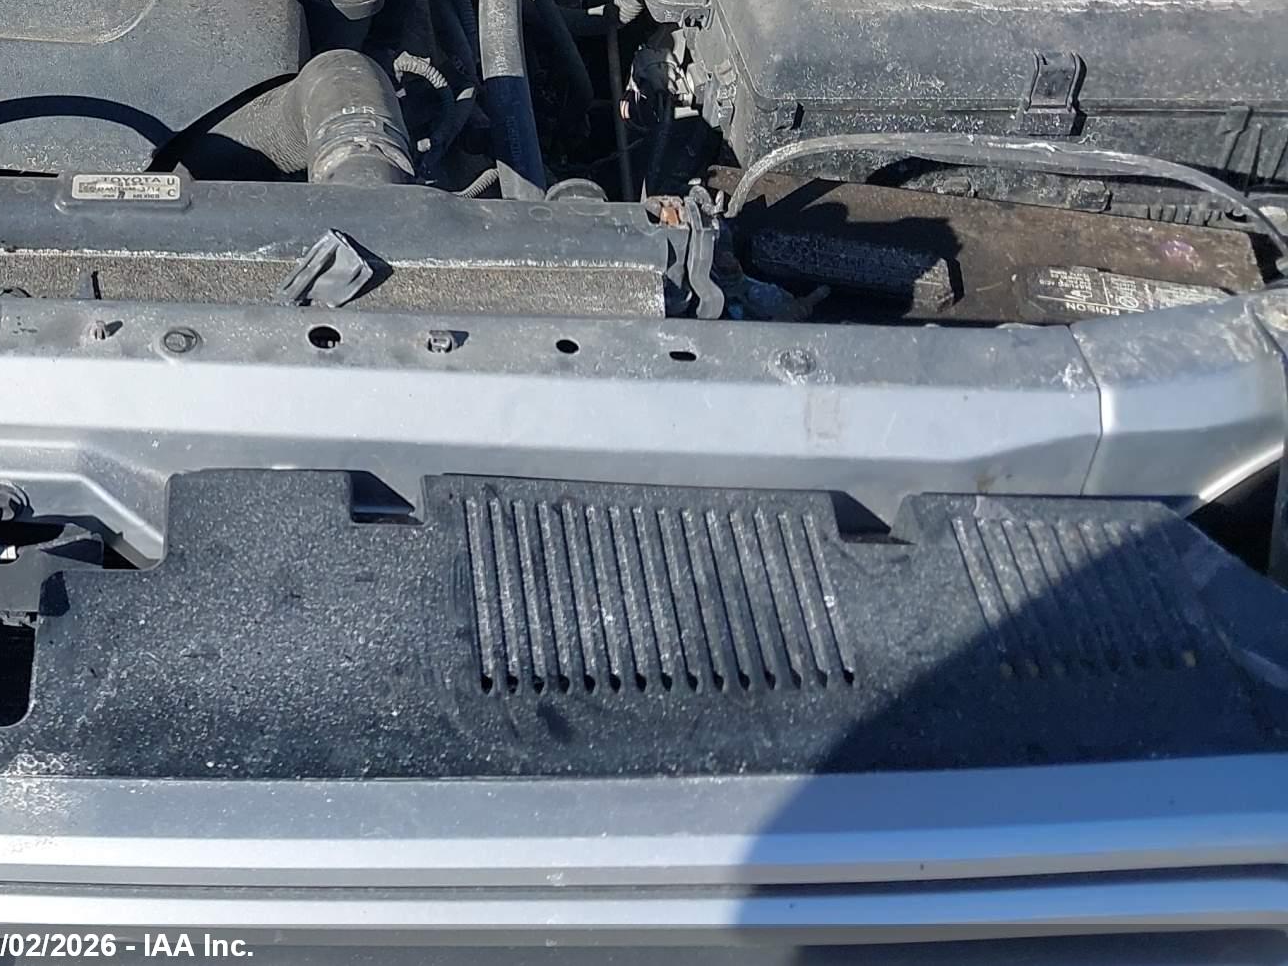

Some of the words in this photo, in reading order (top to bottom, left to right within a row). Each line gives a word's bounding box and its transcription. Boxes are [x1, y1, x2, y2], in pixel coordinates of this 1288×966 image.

[103, 176, 161, 185] TOYOTA
[167, 177, 175, 186] U
[167, 189, 176, 198] C
[1065, 301, 1120, 317] POISON
